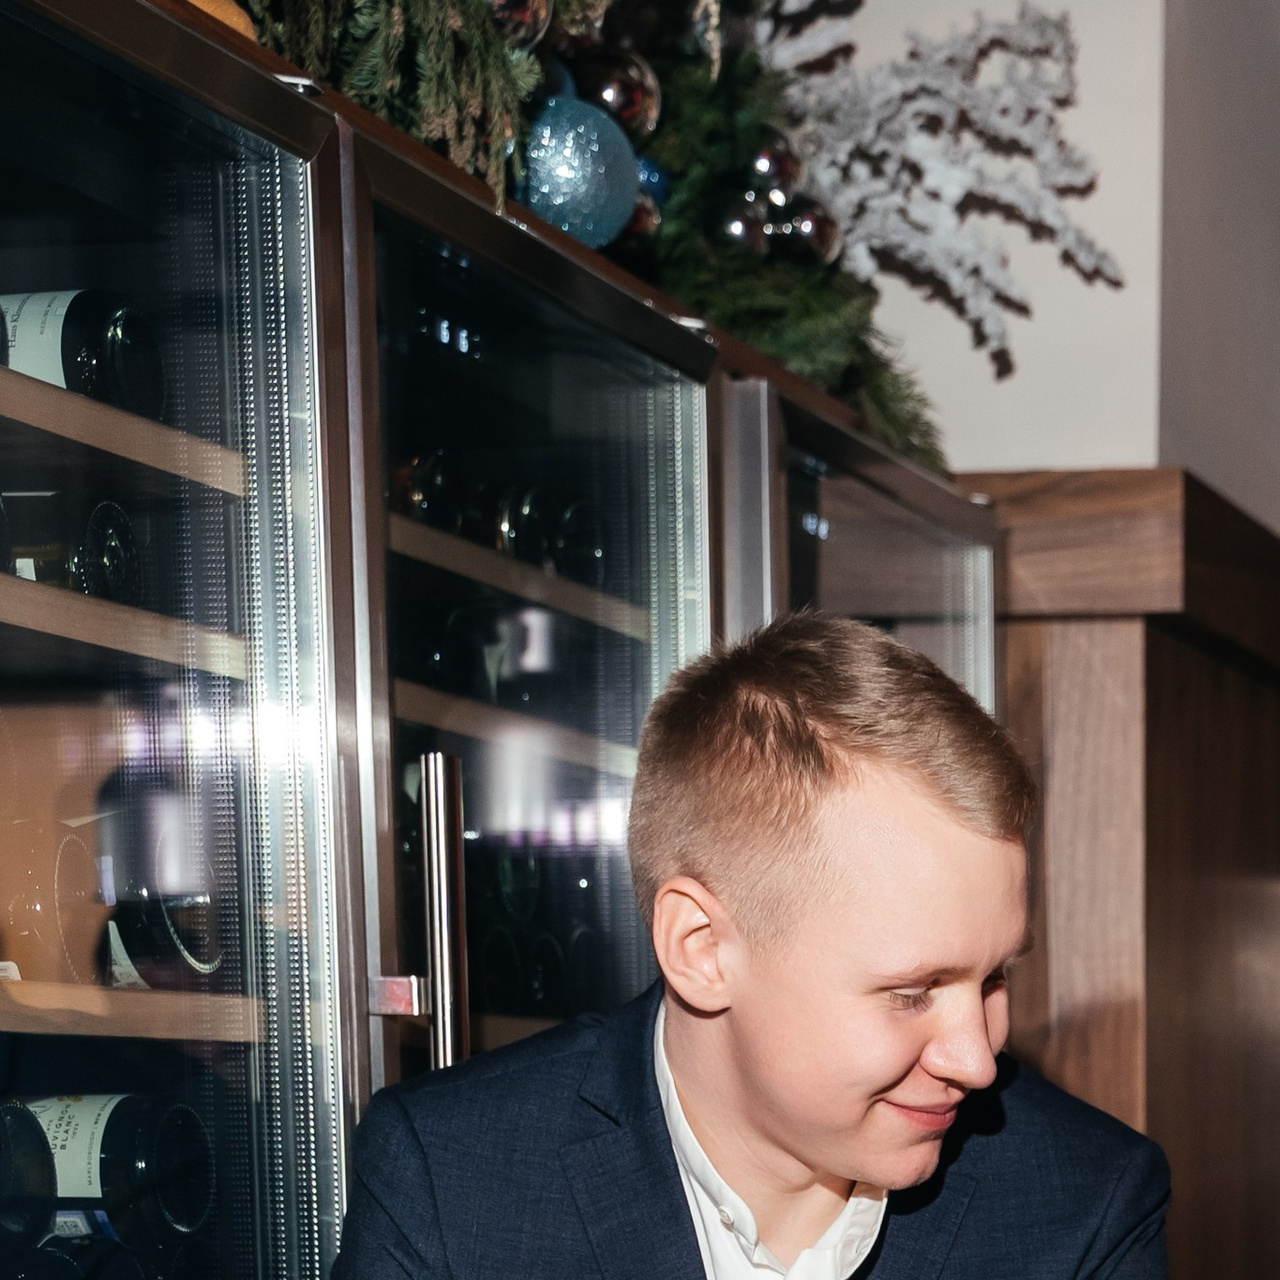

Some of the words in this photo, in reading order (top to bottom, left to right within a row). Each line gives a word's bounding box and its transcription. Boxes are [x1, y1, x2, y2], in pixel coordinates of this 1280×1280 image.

[51, 1103, 72, 1154] UVIGNON
[60, 1114, 76, 1150] BLANC
[87, 1131, 95, 1186] MARLBOROUGH
